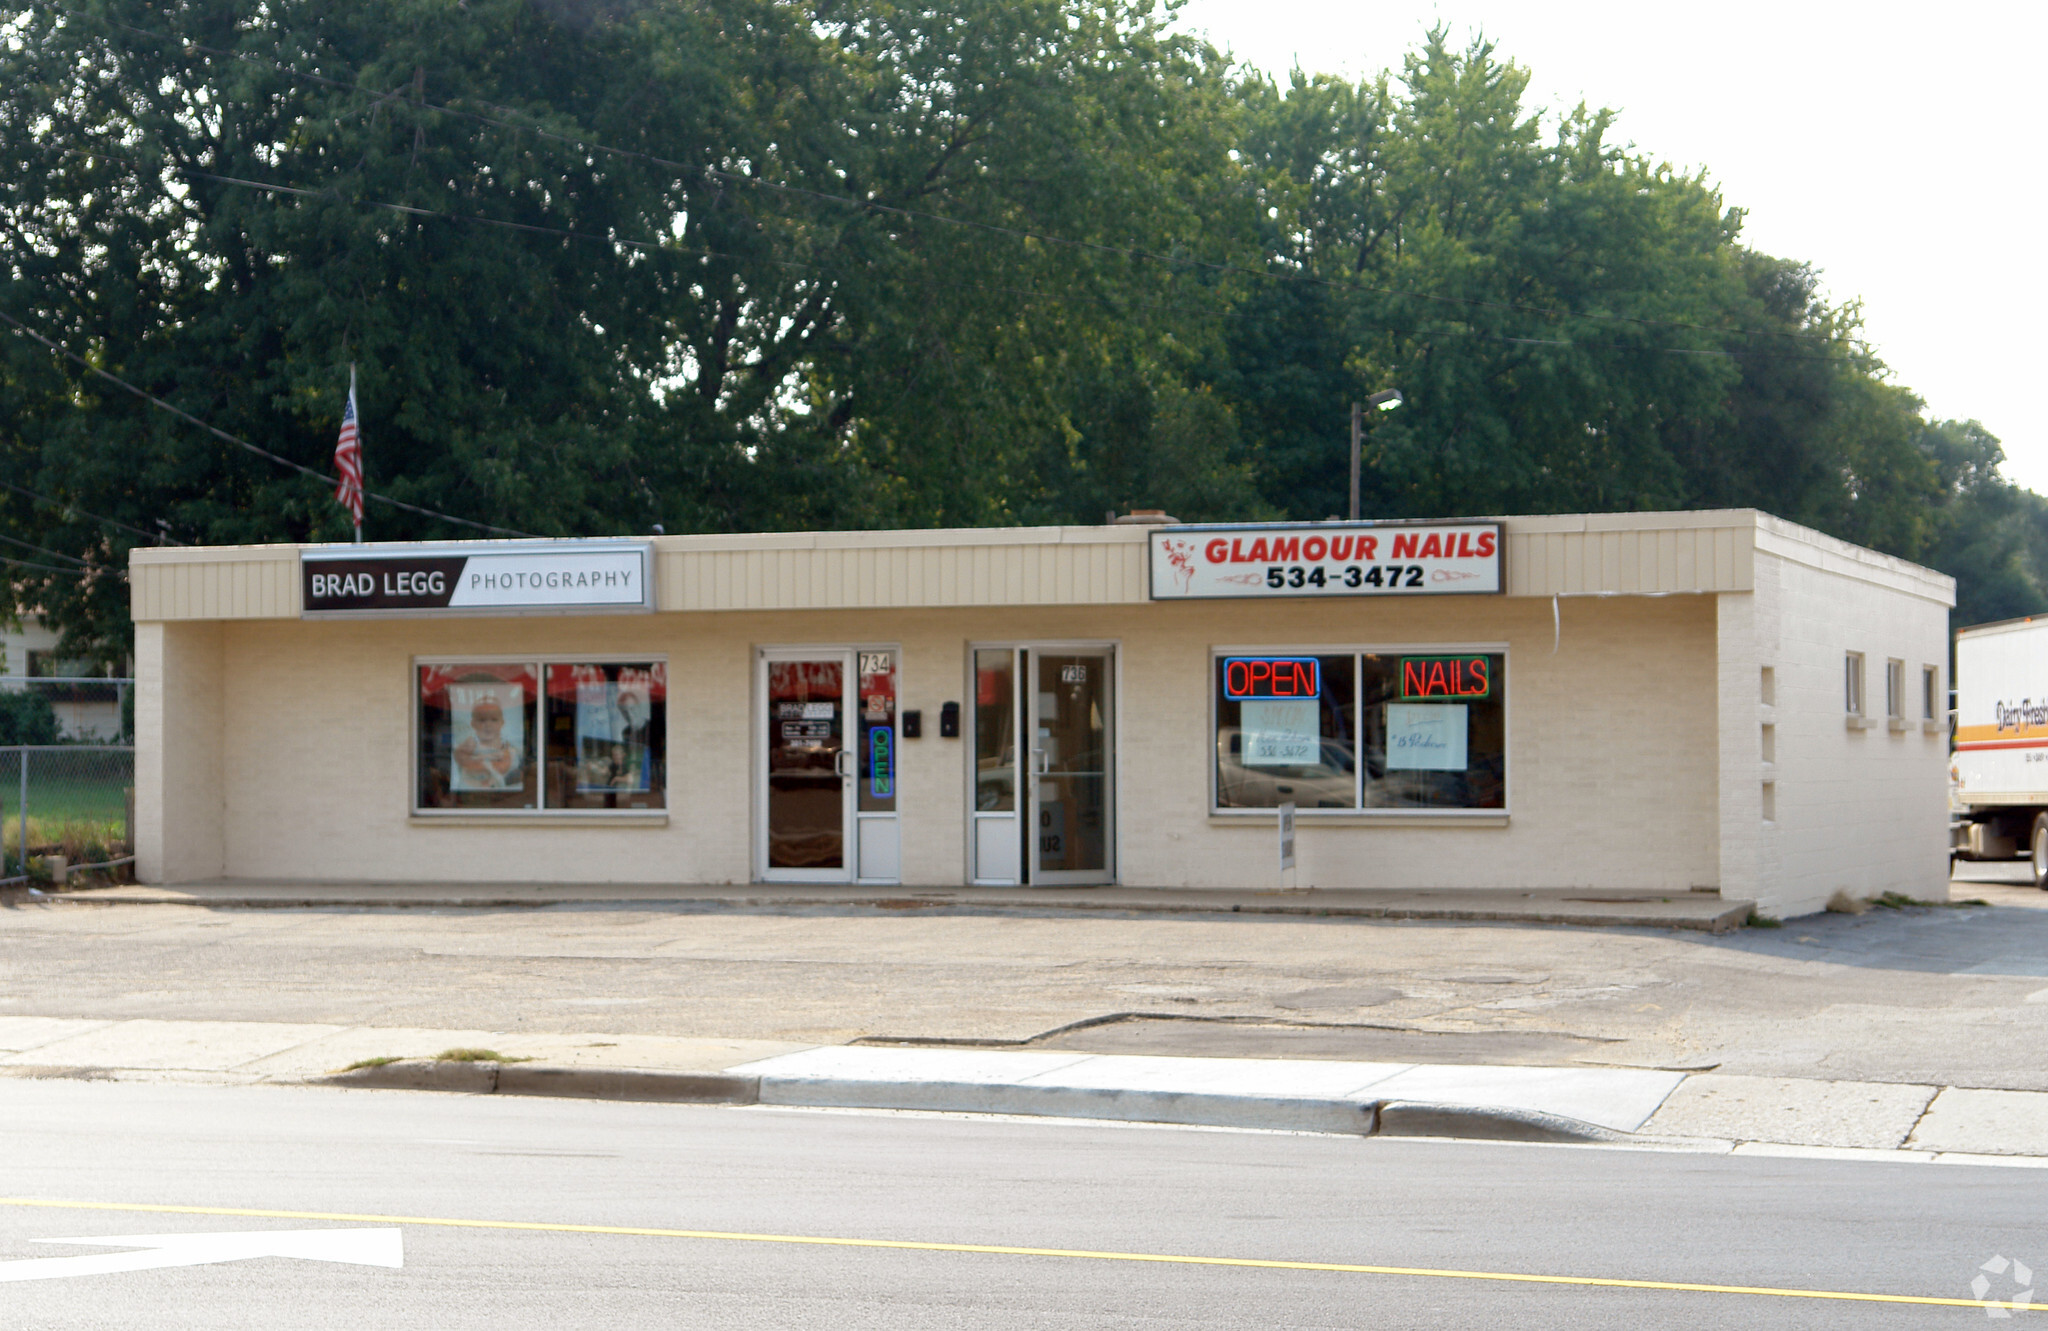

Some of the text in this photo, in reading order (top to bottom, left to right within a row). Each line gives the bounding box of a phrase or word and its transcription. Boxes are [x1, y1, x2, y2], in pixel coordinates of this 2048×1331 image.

[1204, 531, 1497, 565] GLAMOUR NAILS
[311, 570, 633, 598] BRAD LEGG PHOTOGRAPHY
[1266, 564, 1425, 589] 534-3472
[860, 654, 889, 673] 734
[1062, 666, 1086, 681] 736
[1227, 660, 1316, 696] OPEN
[1404, 659, 1488, 697] NAILS
[1996, 699, 2022, 734] Dairy
[873, 729, 889, 795] OPEN
